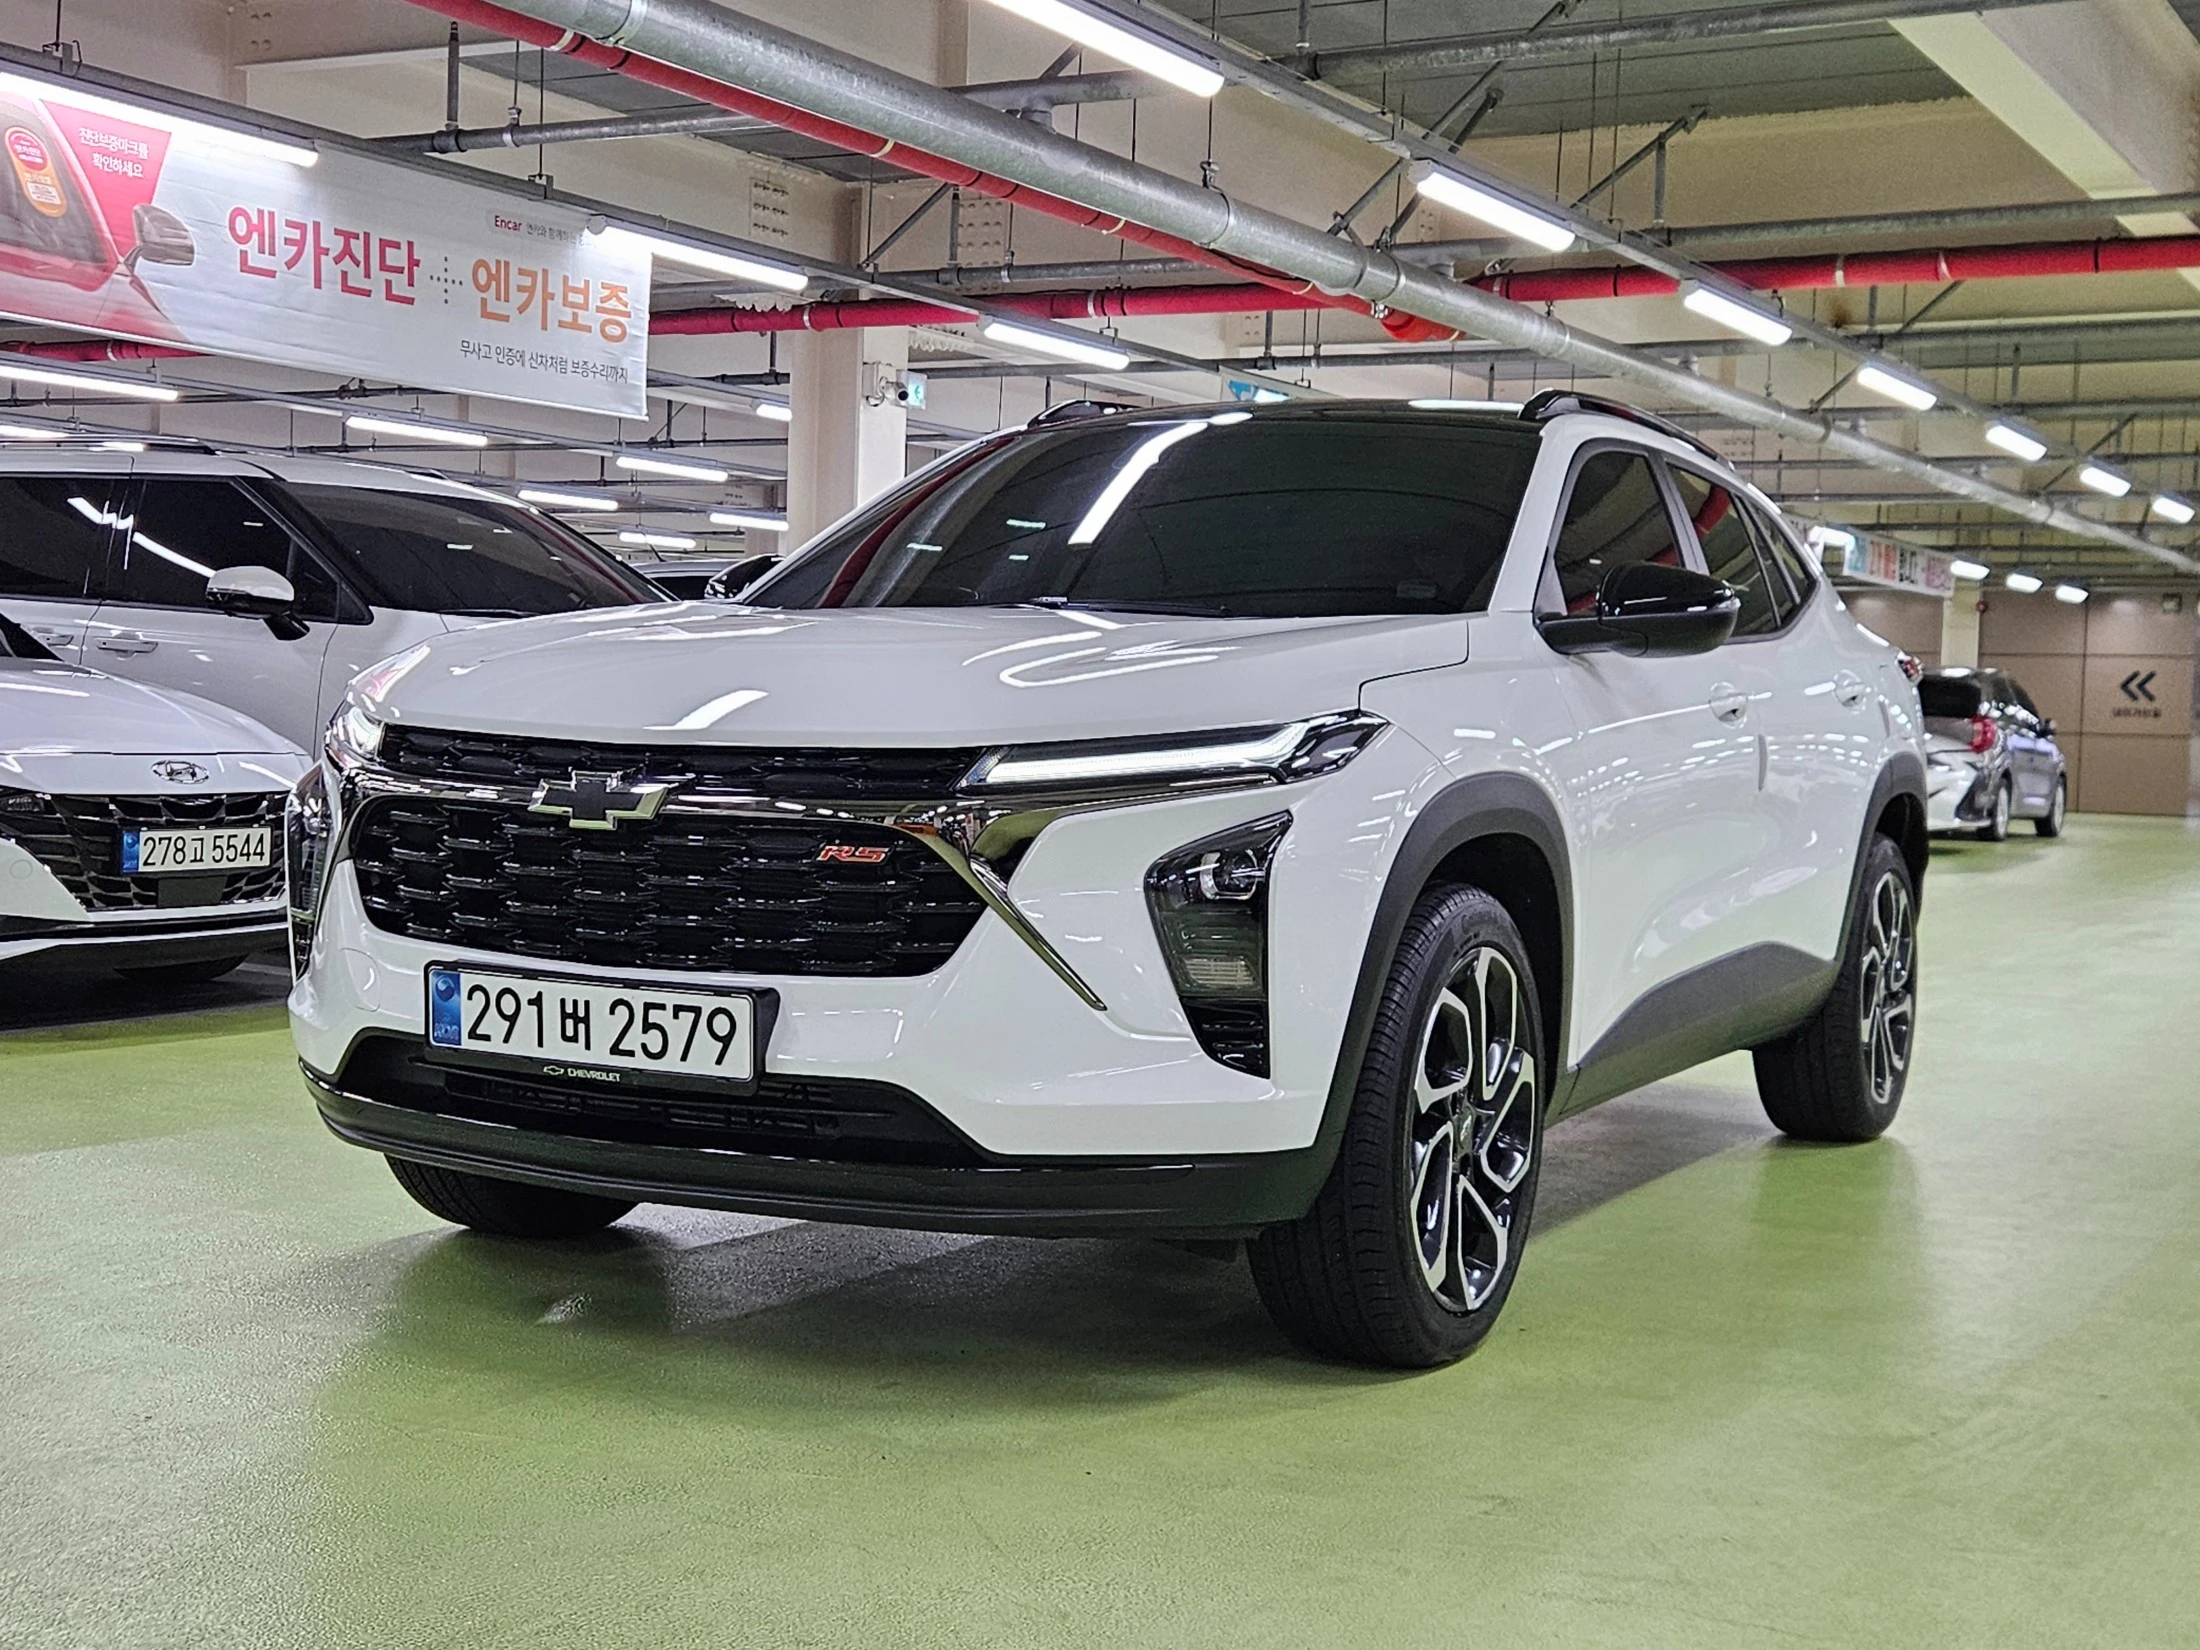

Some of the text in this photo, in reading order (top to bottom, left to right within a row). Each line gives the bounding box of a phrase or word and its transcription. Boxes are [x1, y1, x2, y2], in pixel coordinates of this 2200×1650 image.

[92, 152, 144, 178] 확인하세요
[494, 215, 522, 231] Encar
[228, 206, 632, 344] 엔카진단 엔카보증
[460, 340, 629, 385] 무사고 인증에 신차처럼 보증수리까지
[142, 832, 266, 867] 278고 5544
[816, 845, 887, 863] RS
[466, 983, 738, 1067] 291버 2579
[567, 1067, 620, 1082] CHEVROLET
